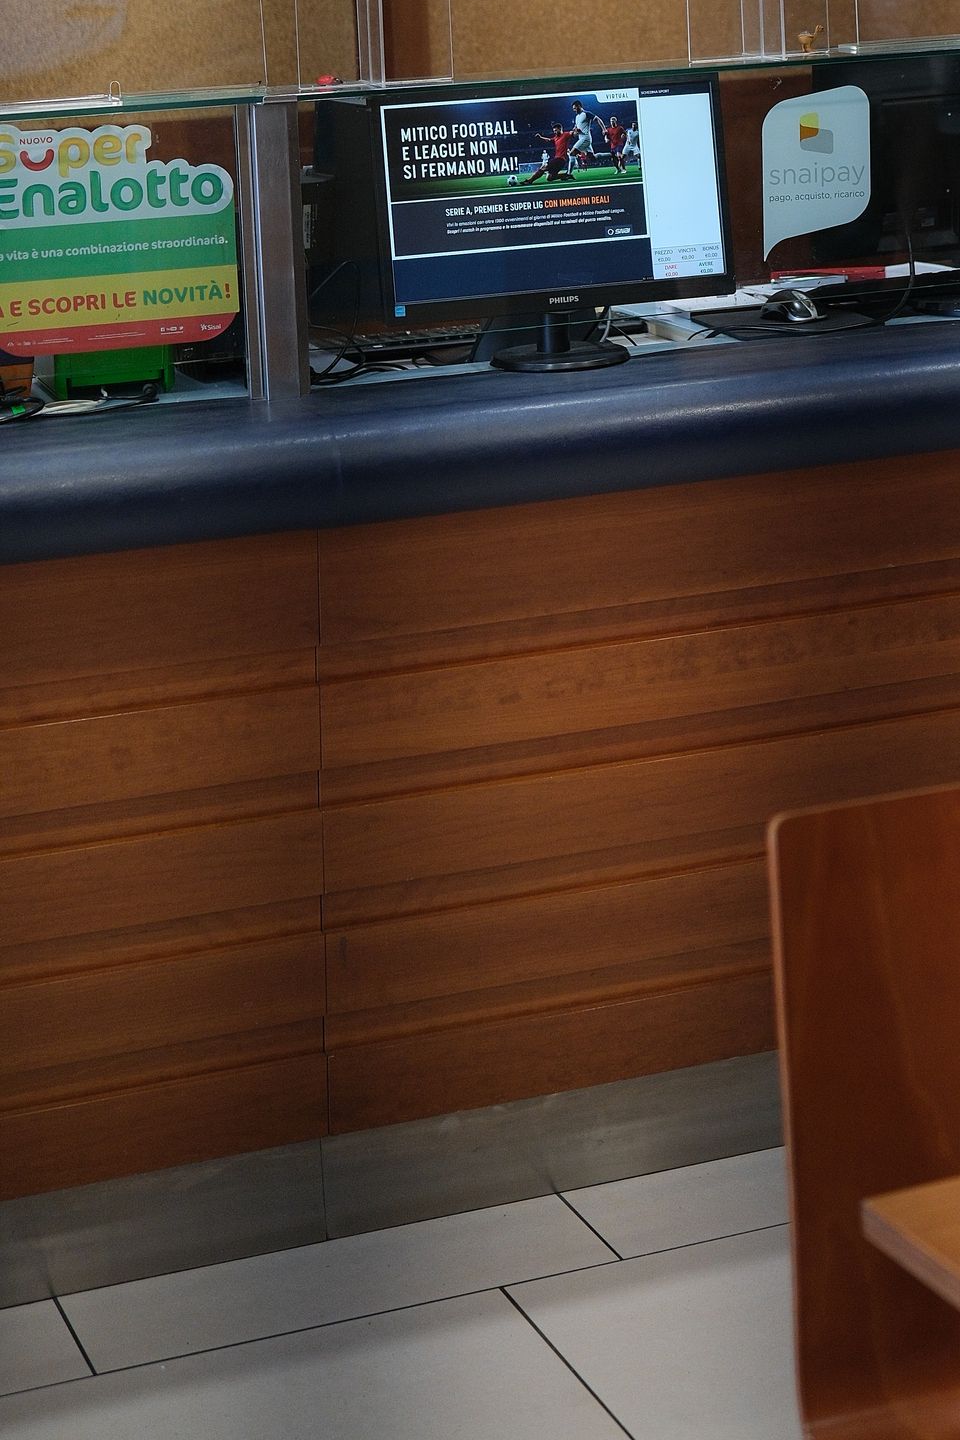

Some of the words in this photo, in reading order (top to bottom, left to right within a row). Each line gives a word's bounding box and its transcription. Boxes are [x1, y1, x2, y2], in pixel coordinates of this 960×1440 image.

[605, 92, 629, 100] VIRTUAL
[19, 136, 53, 145] NUOVO
[400, 125, 448, 143] MITICO
[451, 120, 518, 138] FOOTBALL
[402, 146, 410, 161] E
[414, 142, 465, 160] LEAGUE
[470, 140, 498, 156] NON
[403, 164, 416, 180] SI
[421, 159, 485, 179] FERMANO
[489, 156, 519, 173] MAI!
[769, 162, 865, 187] snaipay
[0, 167, 224, 220] Enalotto
[769, 194, 793, 203] pago,
[795, 192, 832, 201] acquisto,
[834, 190, 865, 199] ricarico
[445, 207, 465, 217] SERIE
[465, 206, 473, 216] A,
[474, 204, 503, 215] PREMIER
[504, 203, 509, 212] E
[510, 202, 532, 212] SUPER
[533, 200, 544, 210] LIG
[544, 198, 558, 209] CON
[559, 197, 590, 208] IMMAGINI
[591, 195, 610, 205] REALI
[6, 250, 29, 261] vita
[31, 248, 38, 259] è
[41, 248, 63, 259] una
[65, 241, 149, 257] combinazione
[151, 234, 229, 250] straordinaria.
[9, 300, 22, 317] E
[28, 293, 106, 316] SCOPRI
[113, 291, 137, 309] LE
[143, 280, 231, 306] NOVITÀ!
[549, 295, 580, 305] PHILIPS
